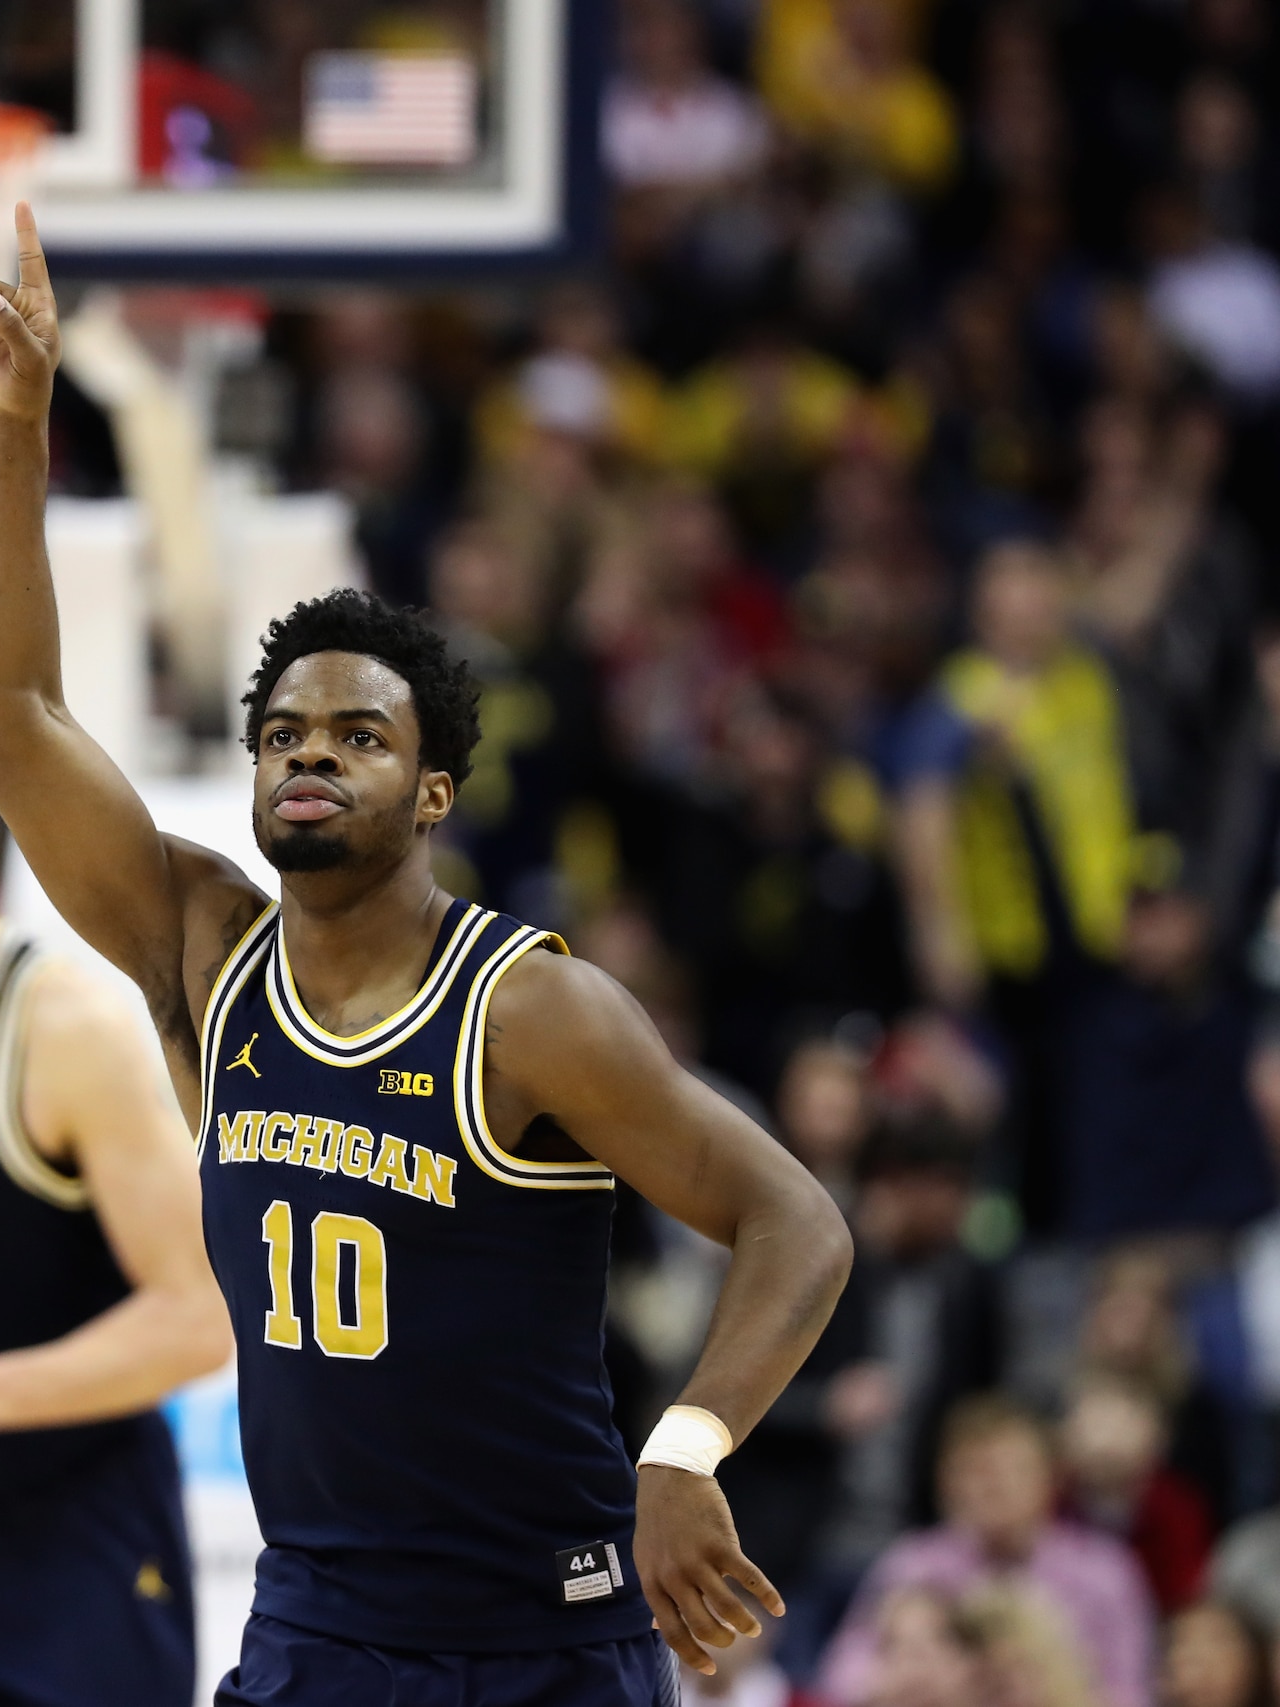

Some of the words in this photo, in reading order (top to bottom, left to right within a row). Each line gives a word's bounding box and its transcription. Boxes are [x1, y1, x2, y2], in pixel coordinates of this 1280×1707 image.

[218, 1111, 459, 1208] MICHIGAN
[262, 1200, 388, 1360] 10
[570, 1552, 596, 1571] 44
